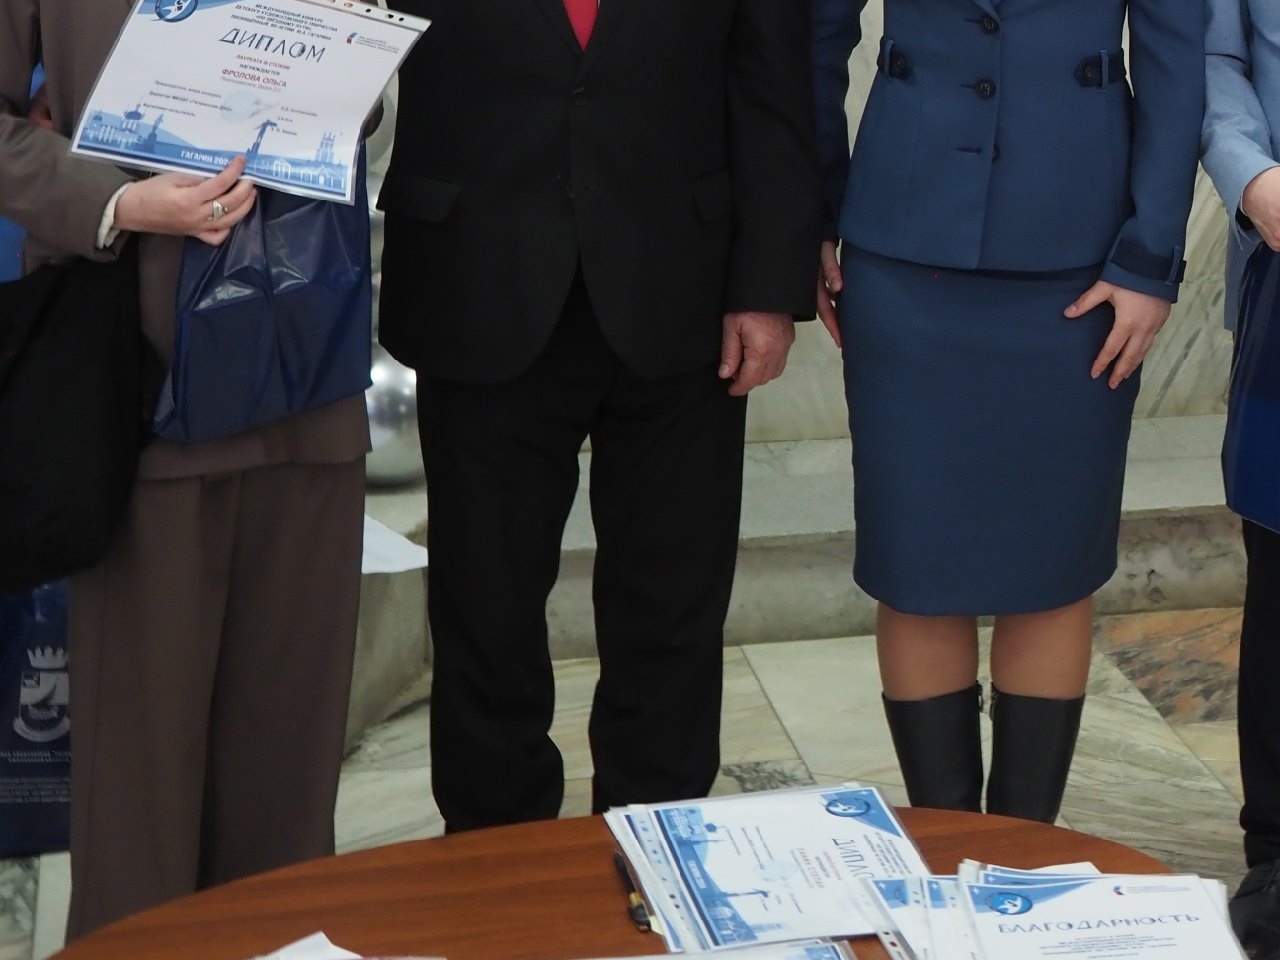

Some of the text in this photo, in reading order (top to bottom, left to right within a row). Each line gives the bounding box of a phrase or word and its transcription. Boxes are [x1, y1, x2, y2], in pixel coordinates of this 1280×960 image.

[218, 27, 326, 63] ДИПЛОМ
[221, 69, 287, 88] ФРОЛОВА ОЛЬГА
[180, 150, 232, 166] ГАГАРИН 202
[832, 838, 877, 879] ДИПЛО
[998, 913, 1201, 934] БЛАГОДАРНОСТЬ
